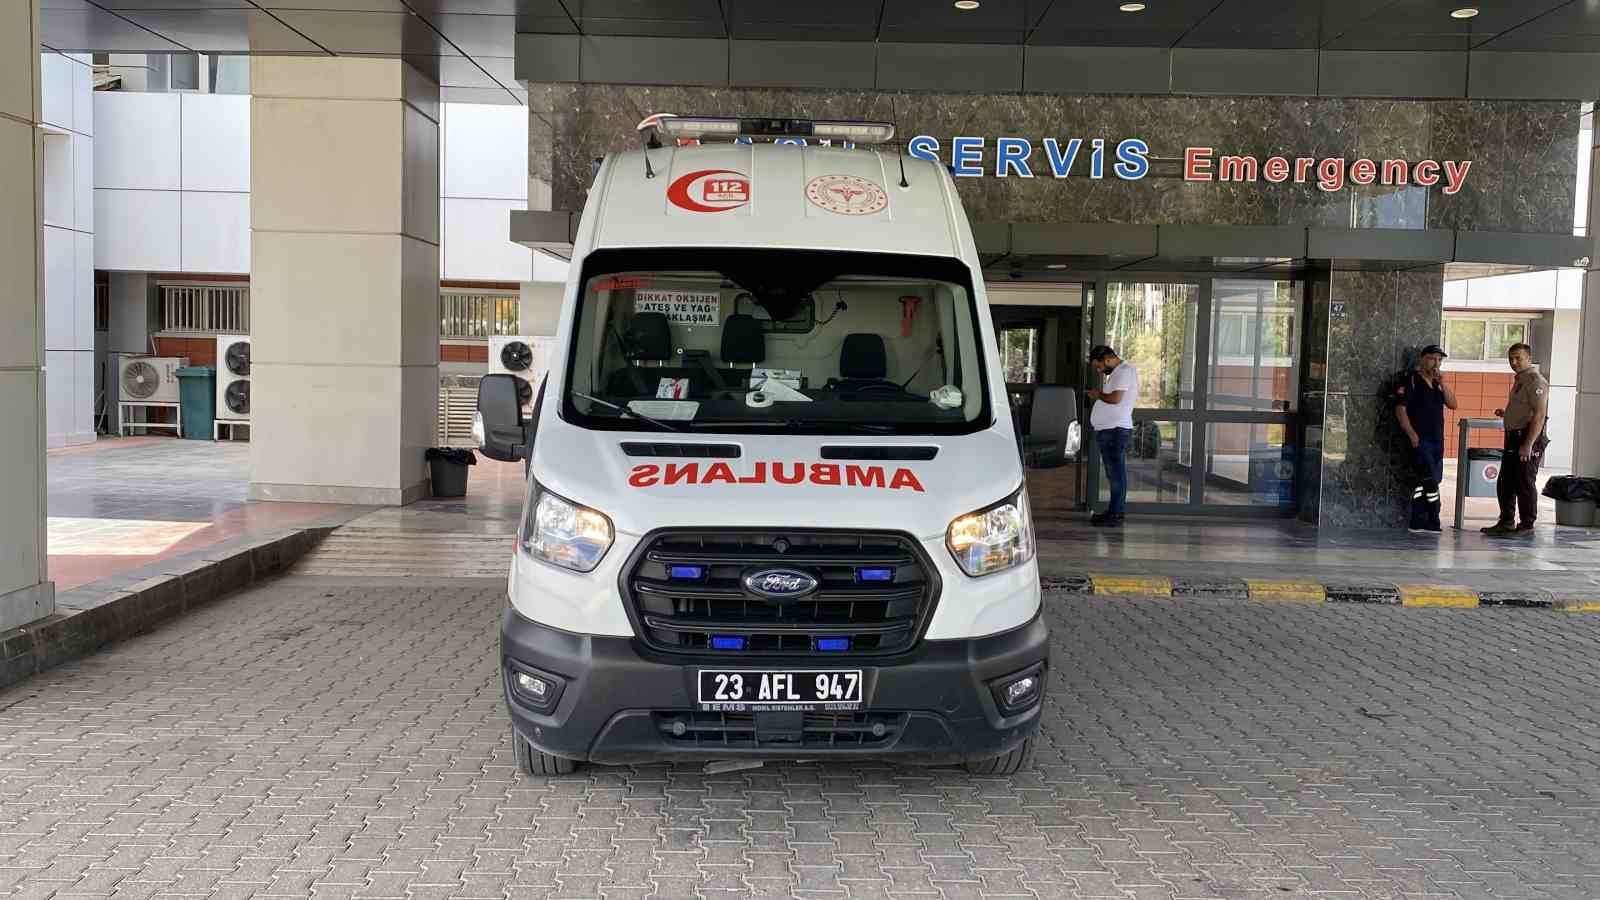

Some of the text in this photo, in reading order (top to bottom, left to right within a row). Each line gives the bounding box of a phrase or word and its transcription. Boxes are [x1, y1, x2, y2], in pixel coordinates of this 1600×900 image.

[1184, 147, 1472, 195] Emergency
[712, 181, 742, 192] 112
[673, 303, 687, 312] VE
[762, 573, 801, 590] Ford
[714, 673, 859, 700] 23 AFL 947
